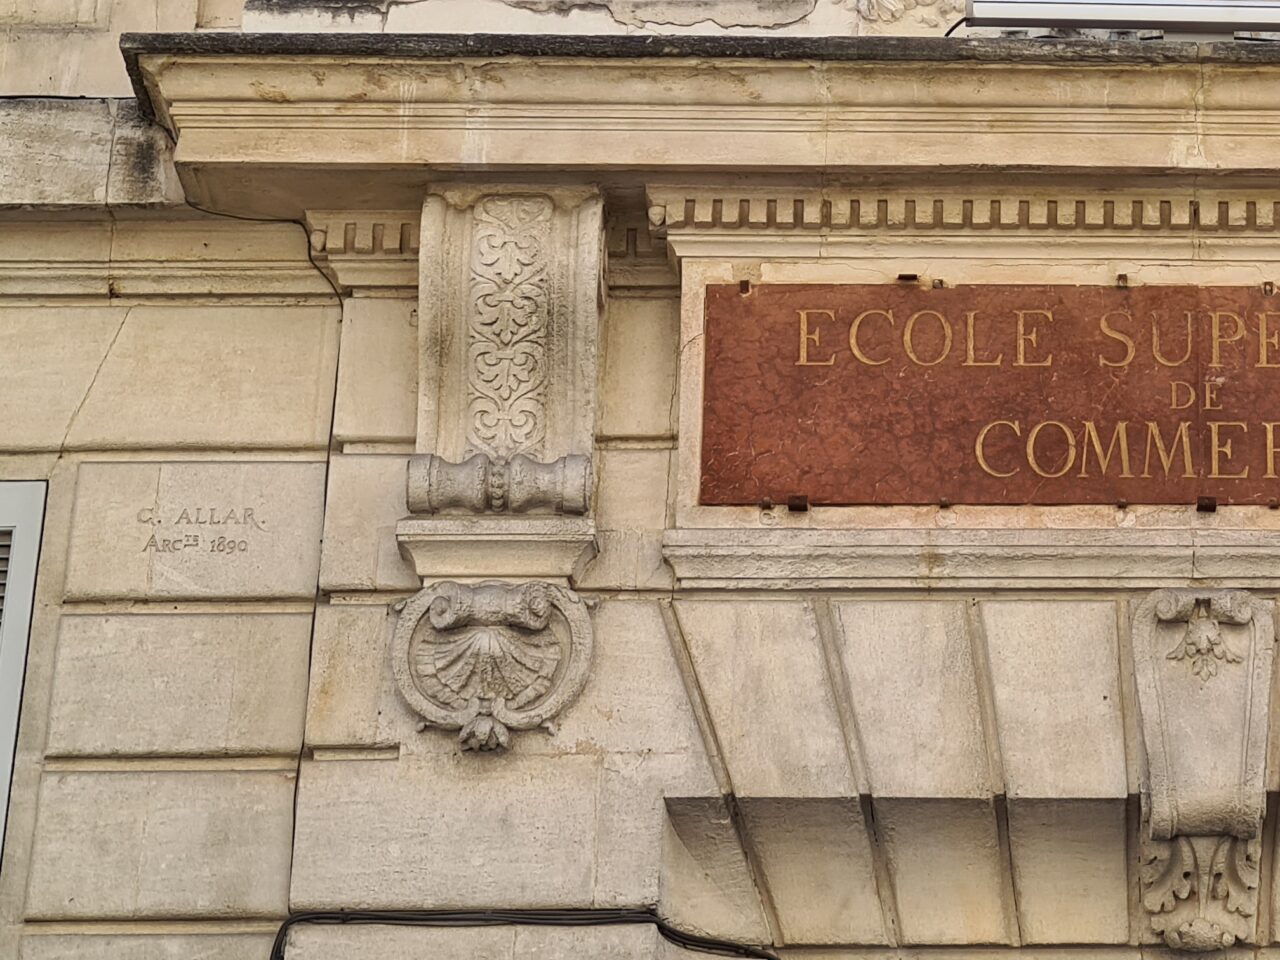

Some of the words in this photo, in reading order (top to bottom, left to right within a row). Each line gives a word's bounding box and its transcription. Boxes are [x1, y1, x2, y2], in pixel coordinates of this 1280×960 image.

[794, 309, 1055, 368] ECOLE
[1170, 379, 1225, 411] DE
[210, 536, 248, 554] 1890
